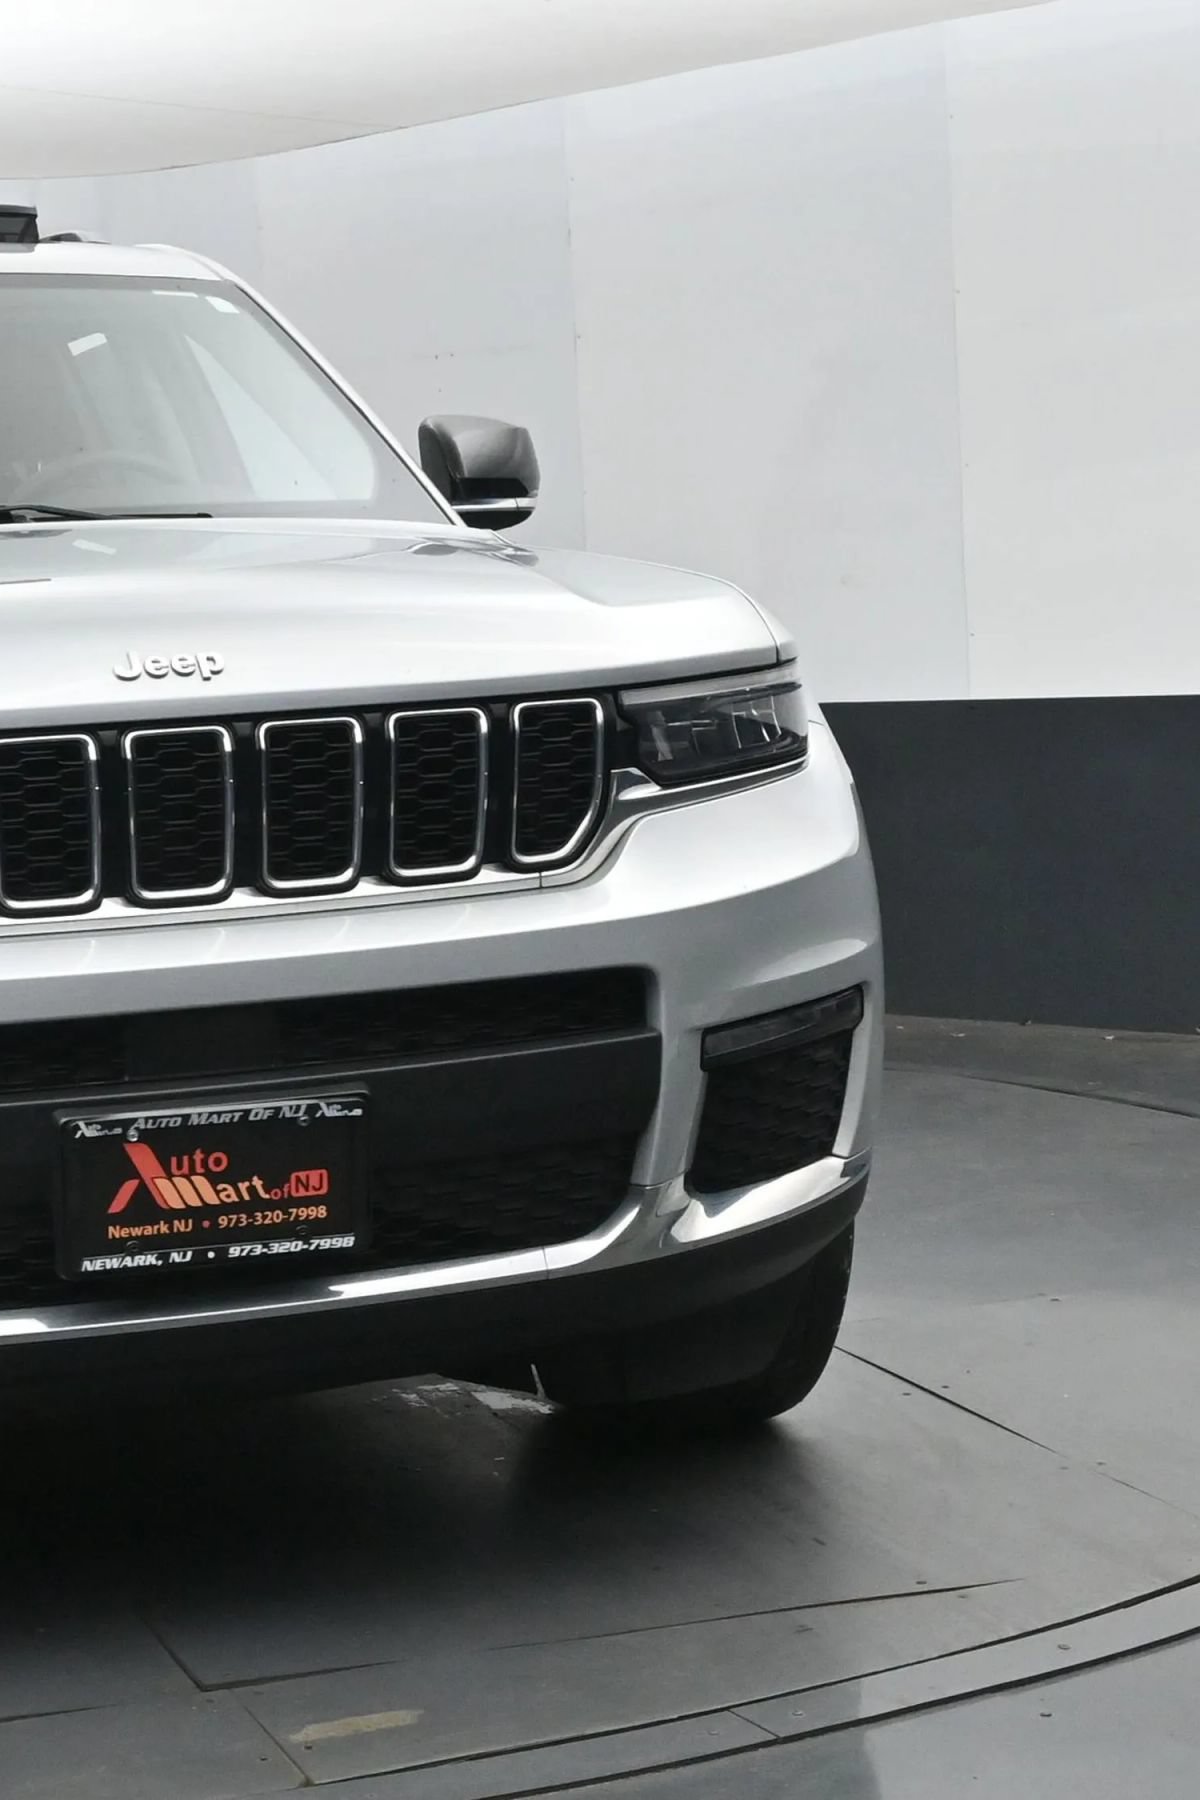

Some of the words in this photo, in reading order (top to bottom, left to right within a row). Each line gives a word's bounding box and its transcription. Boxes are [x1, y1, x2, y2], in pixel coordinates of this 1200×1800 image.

[112, 650, 225, 681] Jeep
[278, 1103, 307, 1119] NJ
[107, 1142, 229, 1214] Auto
[151, 1174, 270, 1209] Mart
[271, 1183, 292, 1200] of
[295, 1171, 324, 1194] NJ
[108, 1220, 170, 1239] Newark
[173, 1218, 193, 1233] NJ
[217, 1205, 328, 1229] 973-320-7998
[81, 1253, 164, 1272] NEWARK,
[169, 1250, 193, 1264] NJ
[227, 1236, 356, 1258] 973-320-7998
